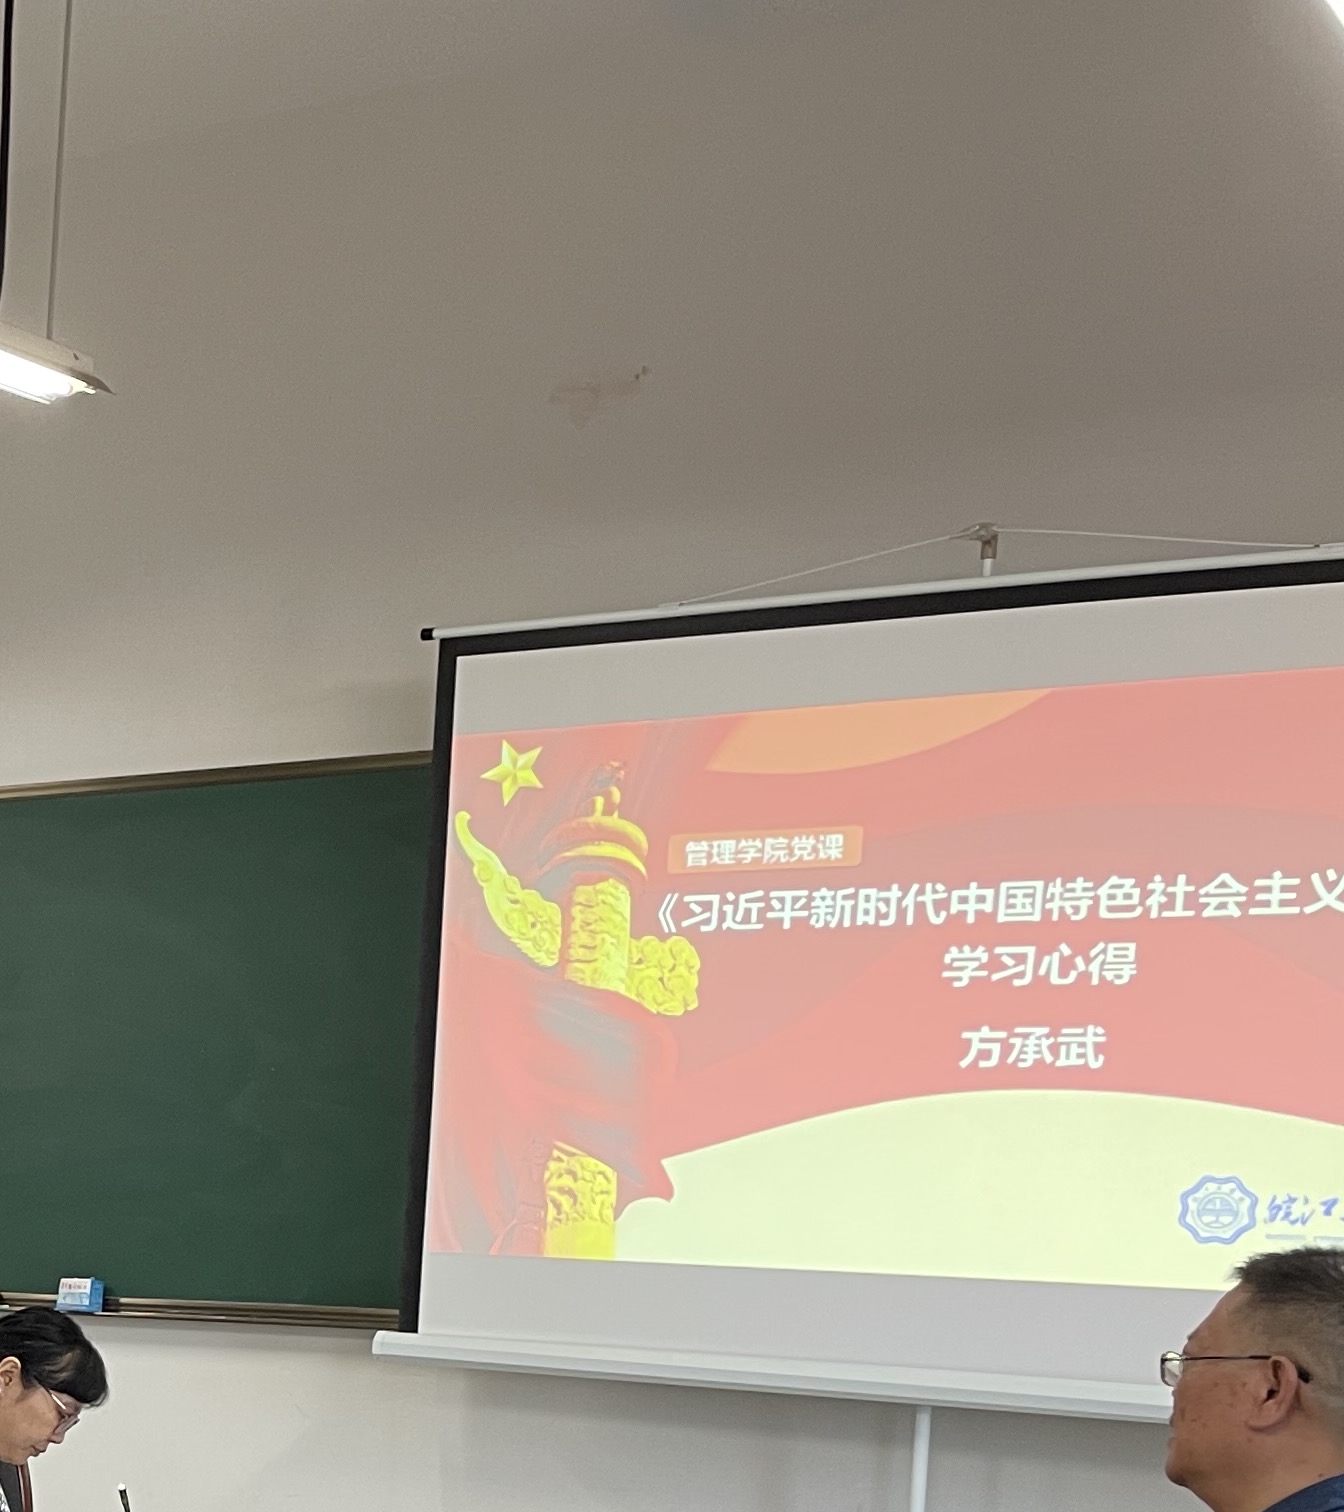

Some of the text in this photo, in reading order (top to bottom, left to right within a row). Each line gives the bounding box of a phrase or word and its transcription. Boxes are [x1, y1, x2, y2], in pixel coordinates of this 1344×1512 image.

[685, 832, 845, 867] 管理学院党课
[658, 868, 1344, 933] 《习近平新时代中国特色社会主义
[941, 941, 1138, 987] 学习心得
[959, 1025, 1107, 1069] 方承武
